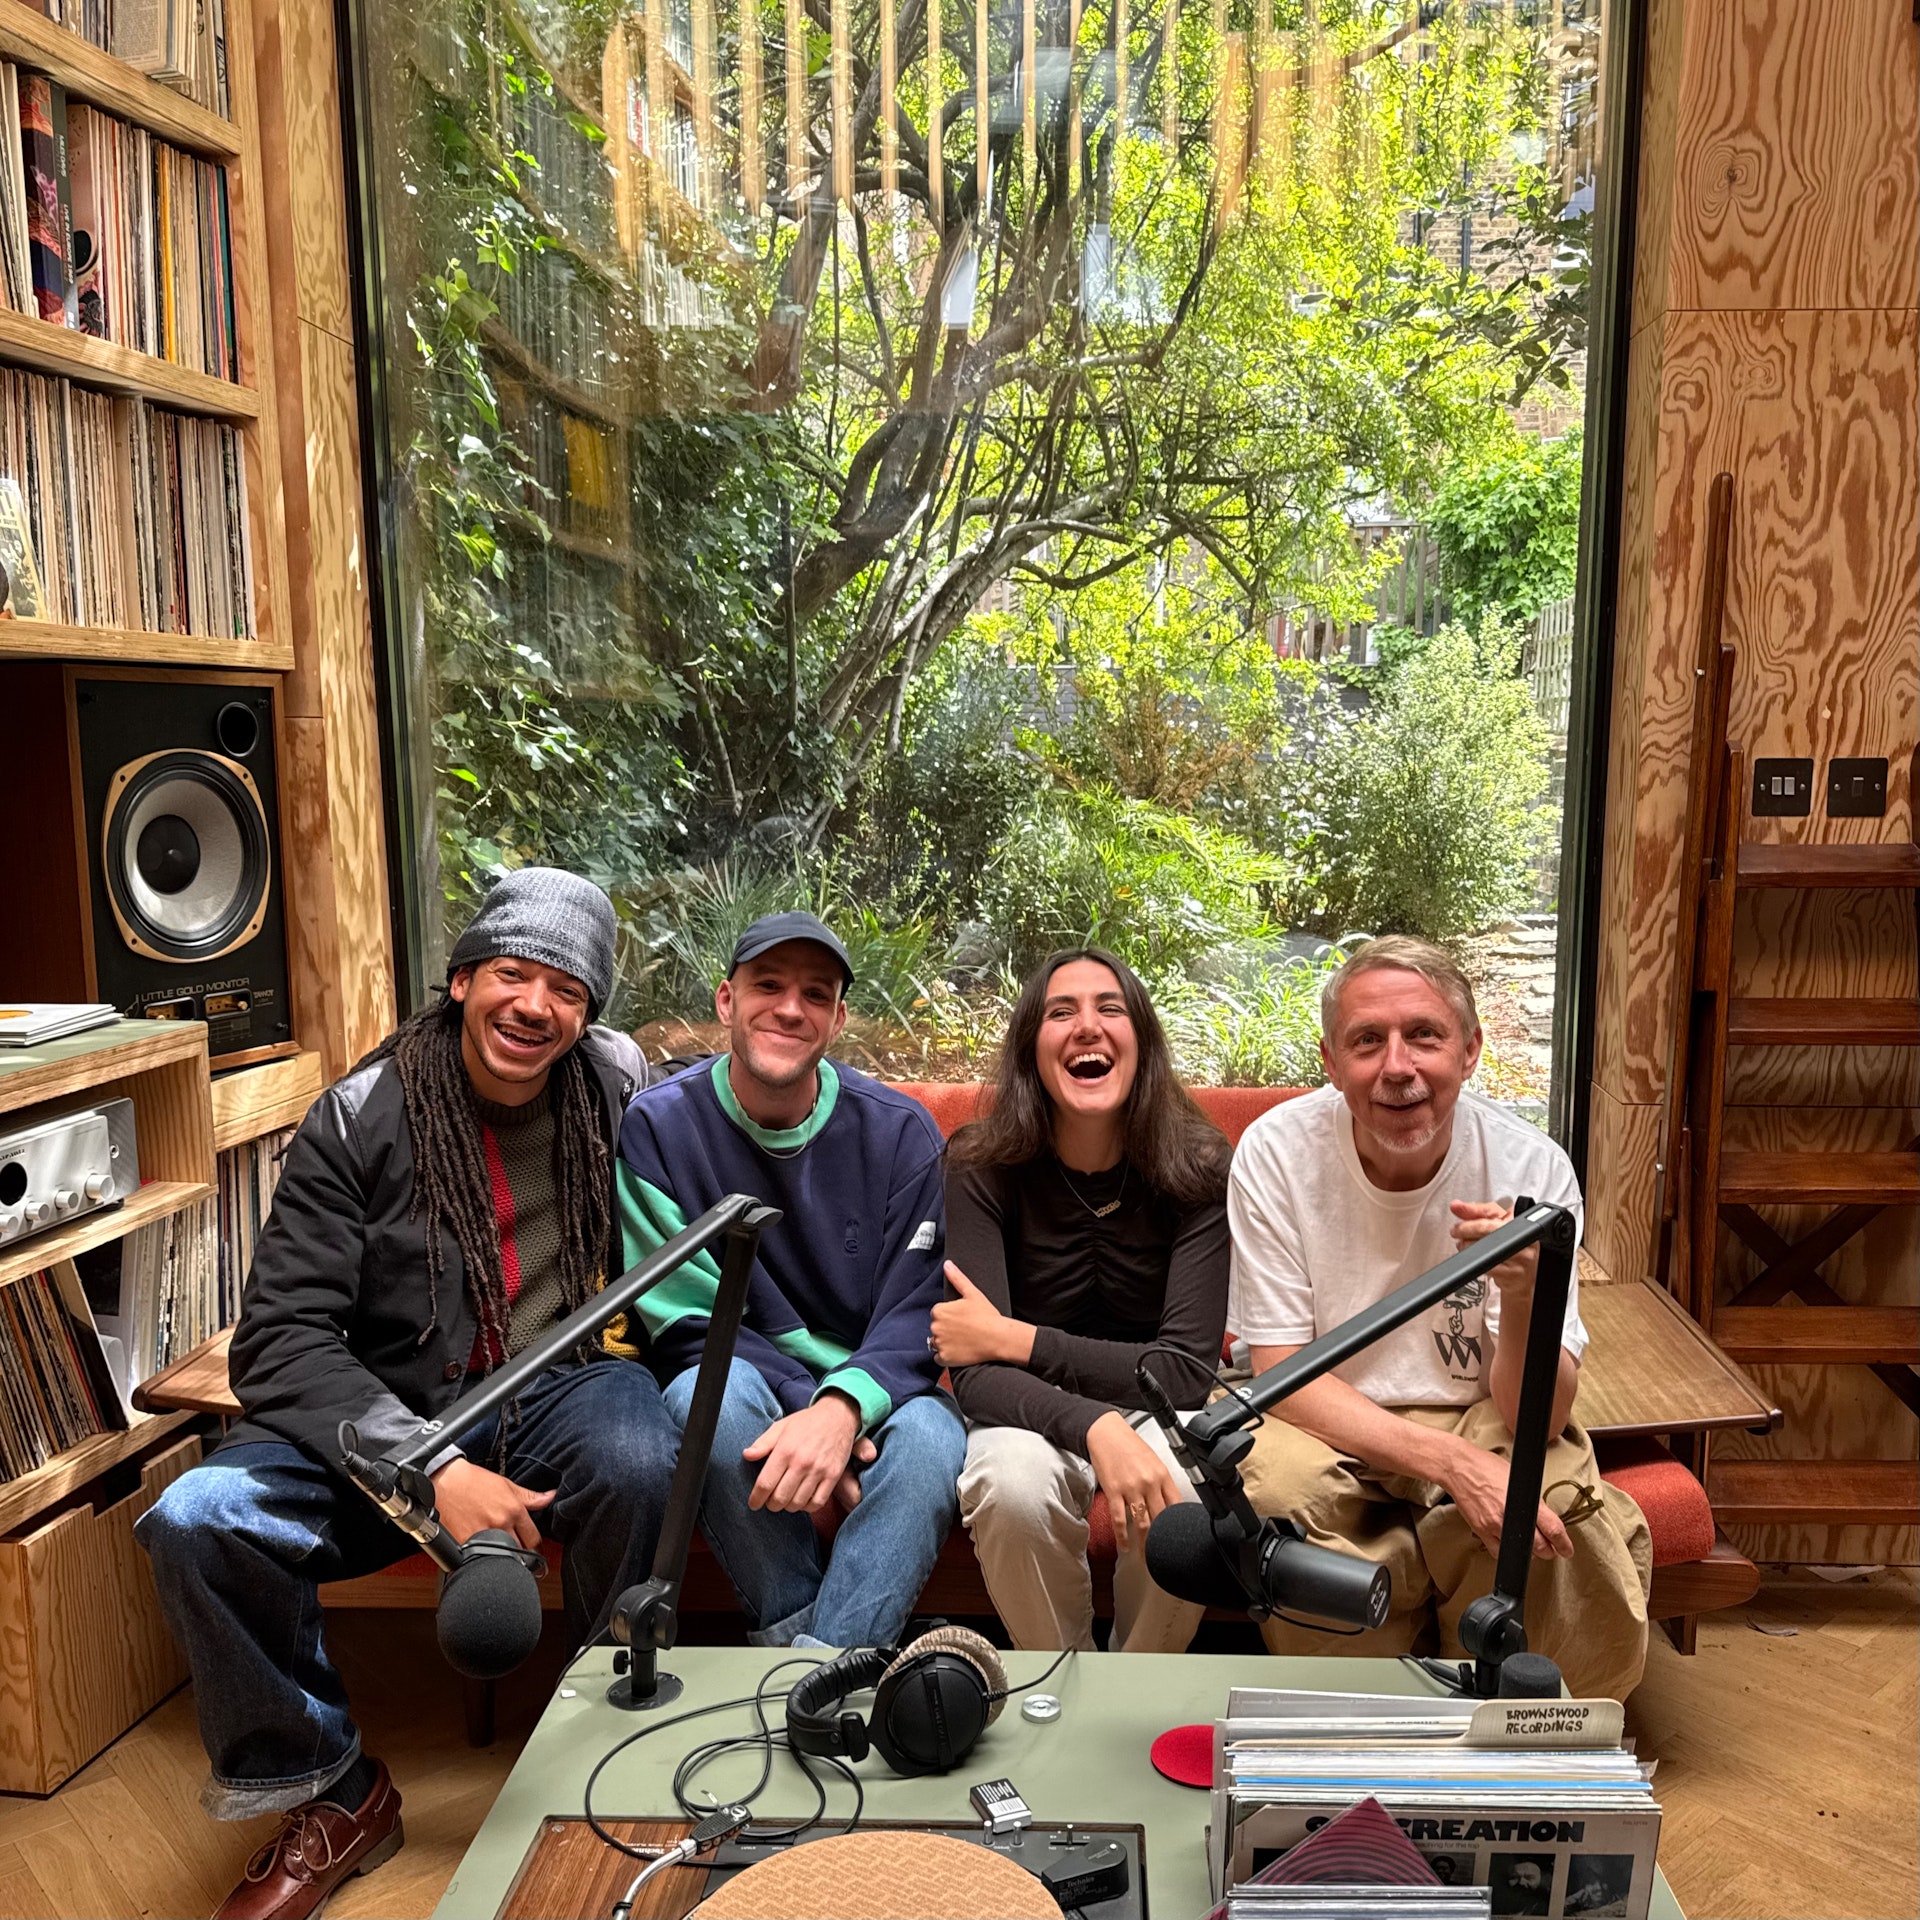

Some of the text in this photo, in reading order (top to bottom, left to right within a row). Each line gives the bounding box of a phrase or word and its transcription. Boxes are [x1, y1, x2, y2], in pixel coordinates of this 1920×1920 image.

[141, 977, 250, 1001] LITTLE GOLD MONITOR
[1506, 1707, 1589, 1720] BROWNSWOOD
[1505, 1720, 1583, 1735] RECORDINGS
